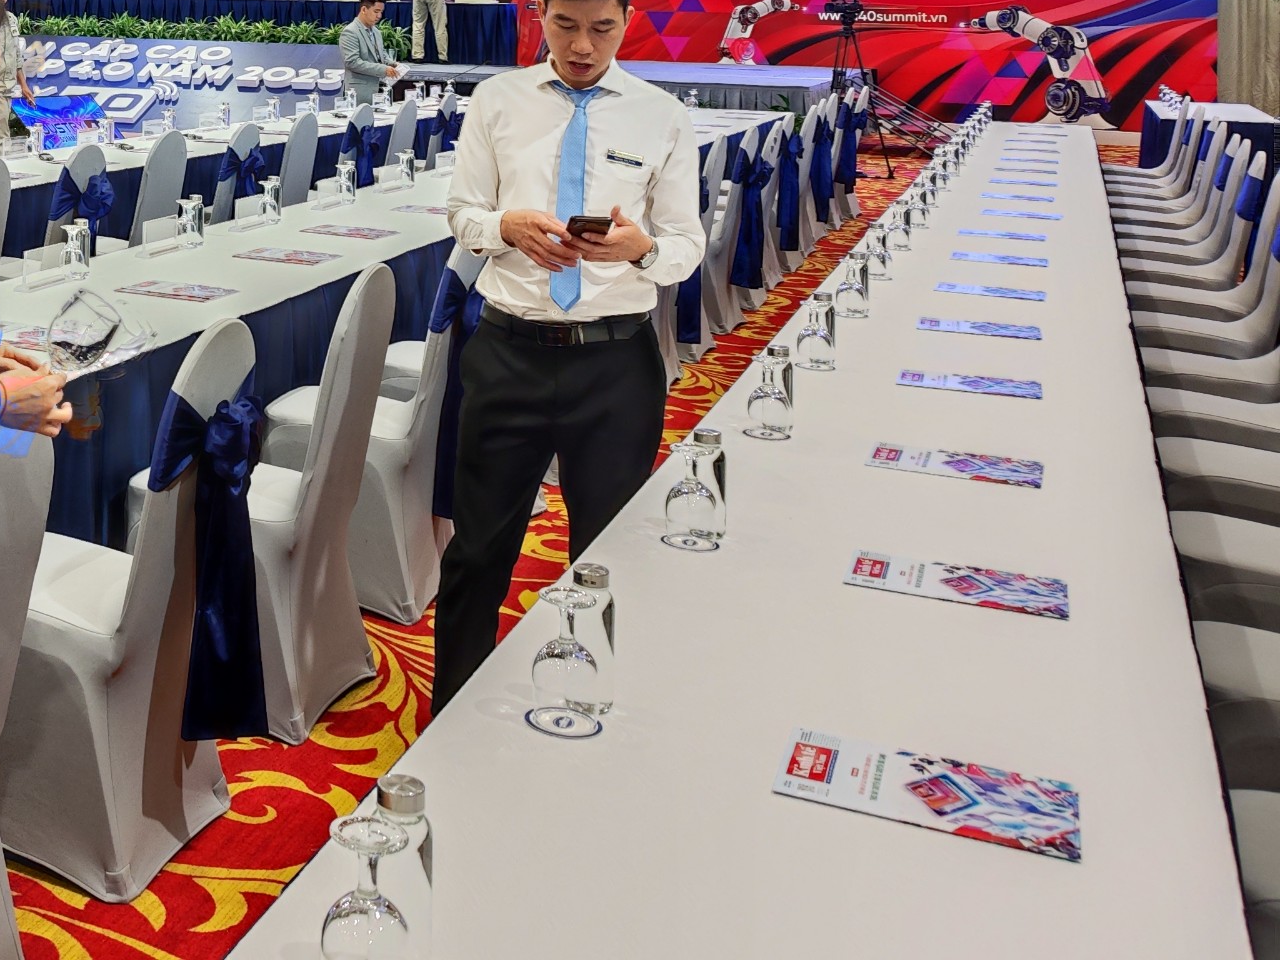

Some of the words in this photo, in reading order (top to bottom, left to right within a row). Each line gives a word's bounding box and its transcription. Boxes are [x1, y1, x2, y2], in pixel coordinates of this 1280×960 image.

[146, 44, 232, 67] CAO
[68, 61, 134, 82] 4.0
[137, 60, 232, 87] NĂM
[236, 66, 345, 90] 2023
